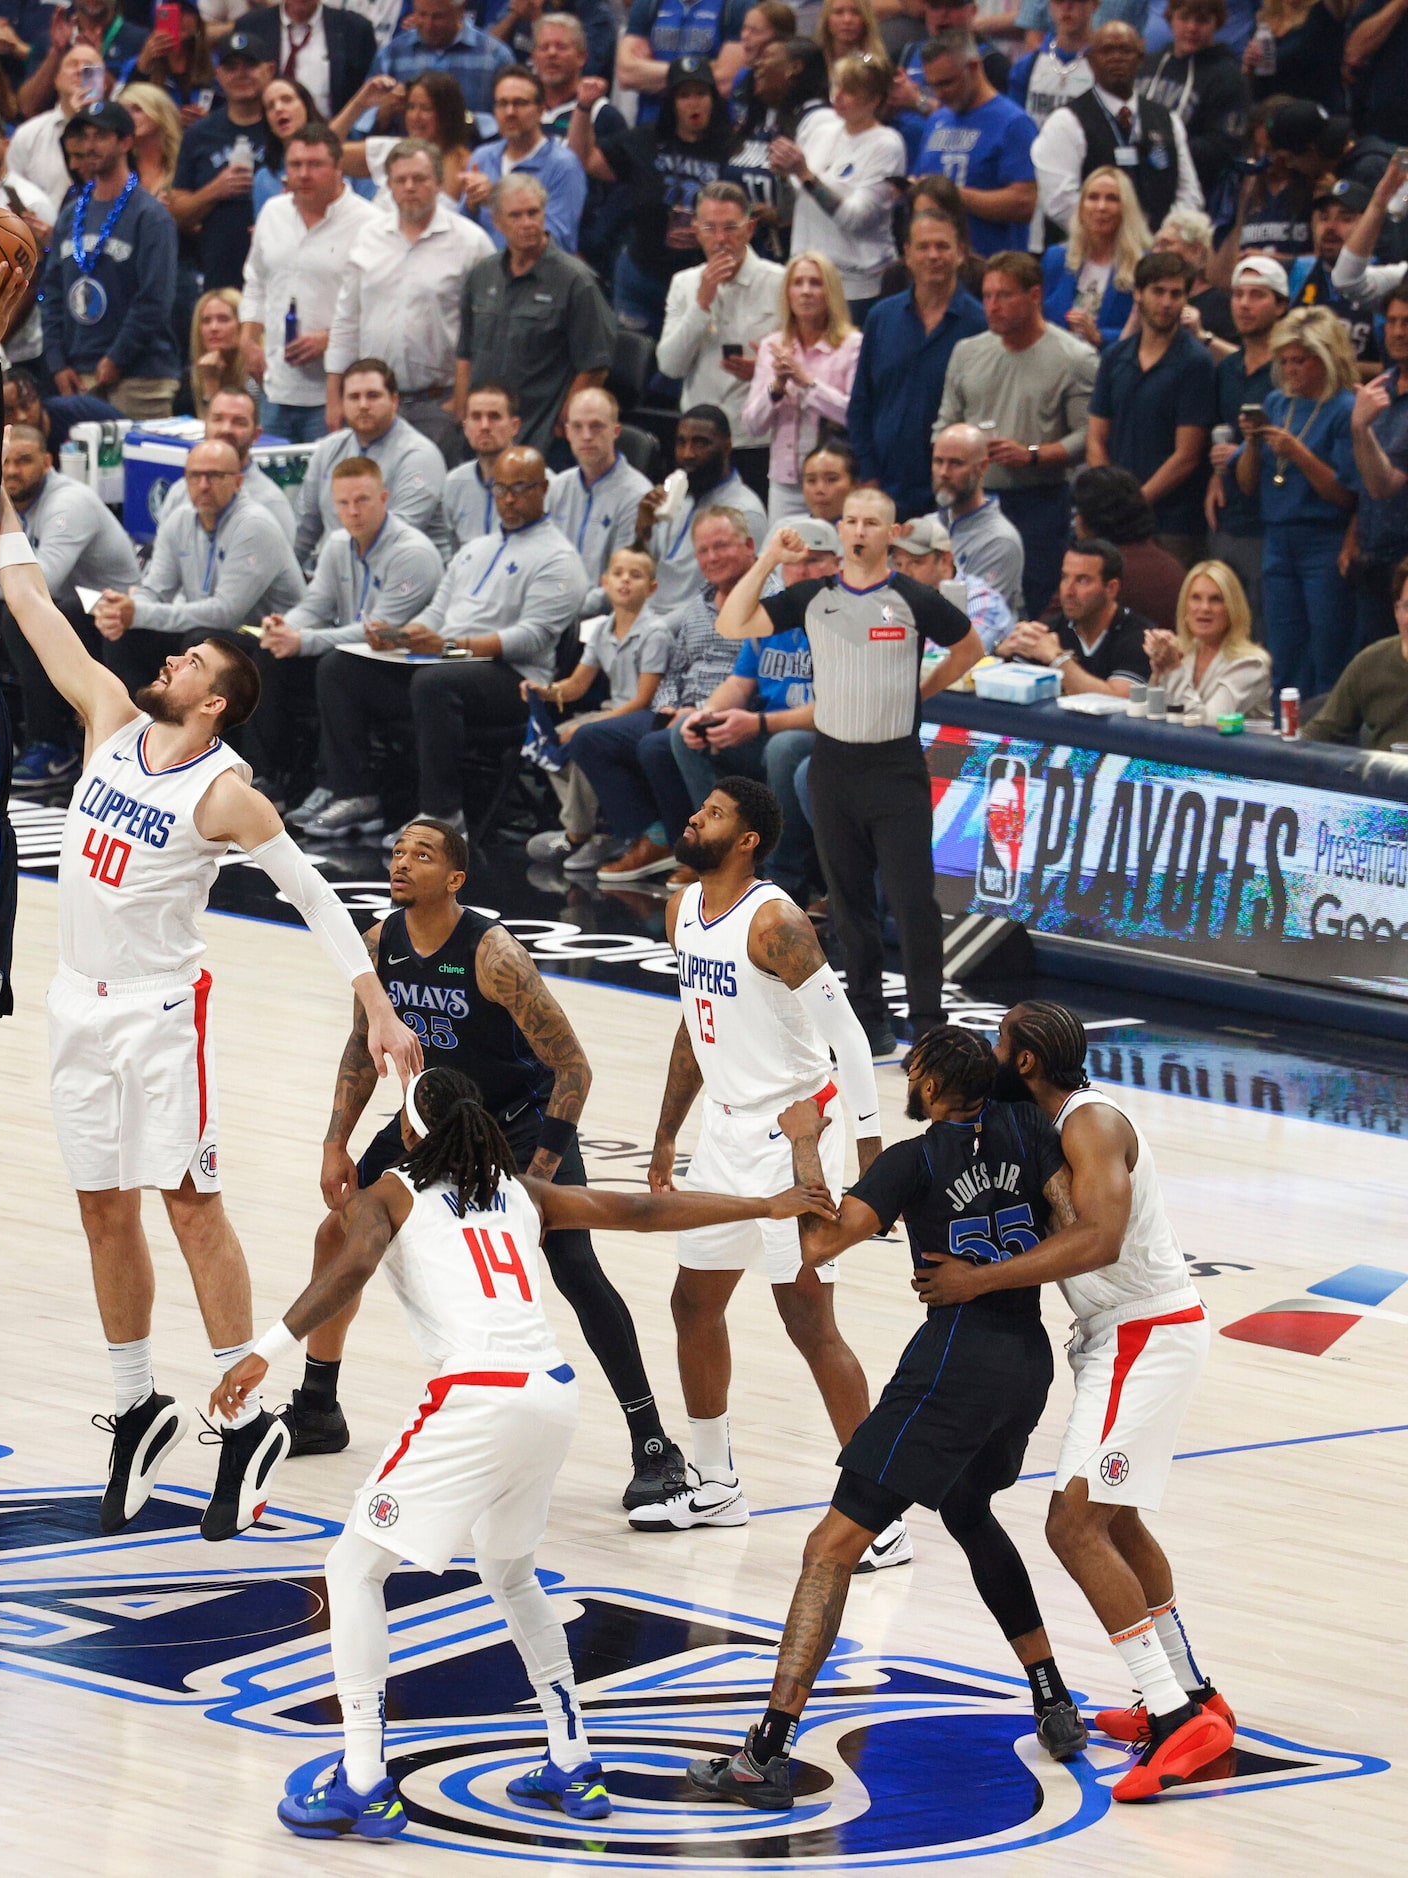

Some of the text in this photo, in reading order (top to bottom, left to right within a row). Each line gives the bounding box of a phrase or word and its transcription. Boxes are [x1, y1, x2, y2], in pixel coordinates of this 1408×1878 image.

[79, 776, 176, 849] CLIPPERS
[82, 828, 132, 888] 40
[1030, 768, 1299, 940] PLAYOFFS
[438, 963, 465, 974] chime
[678, 950, 738, 998] CLIPPERS
[388, 980, 470, 1019] MAVS
[695, 997, 716, 1044] 13
[403, 1011, 459, 1050] 25
[945, 1161, 1020, 1212] JONES JR.
[949, 1202, 1041, 1266] 55
[462, 1227, 533, 1302] 14
